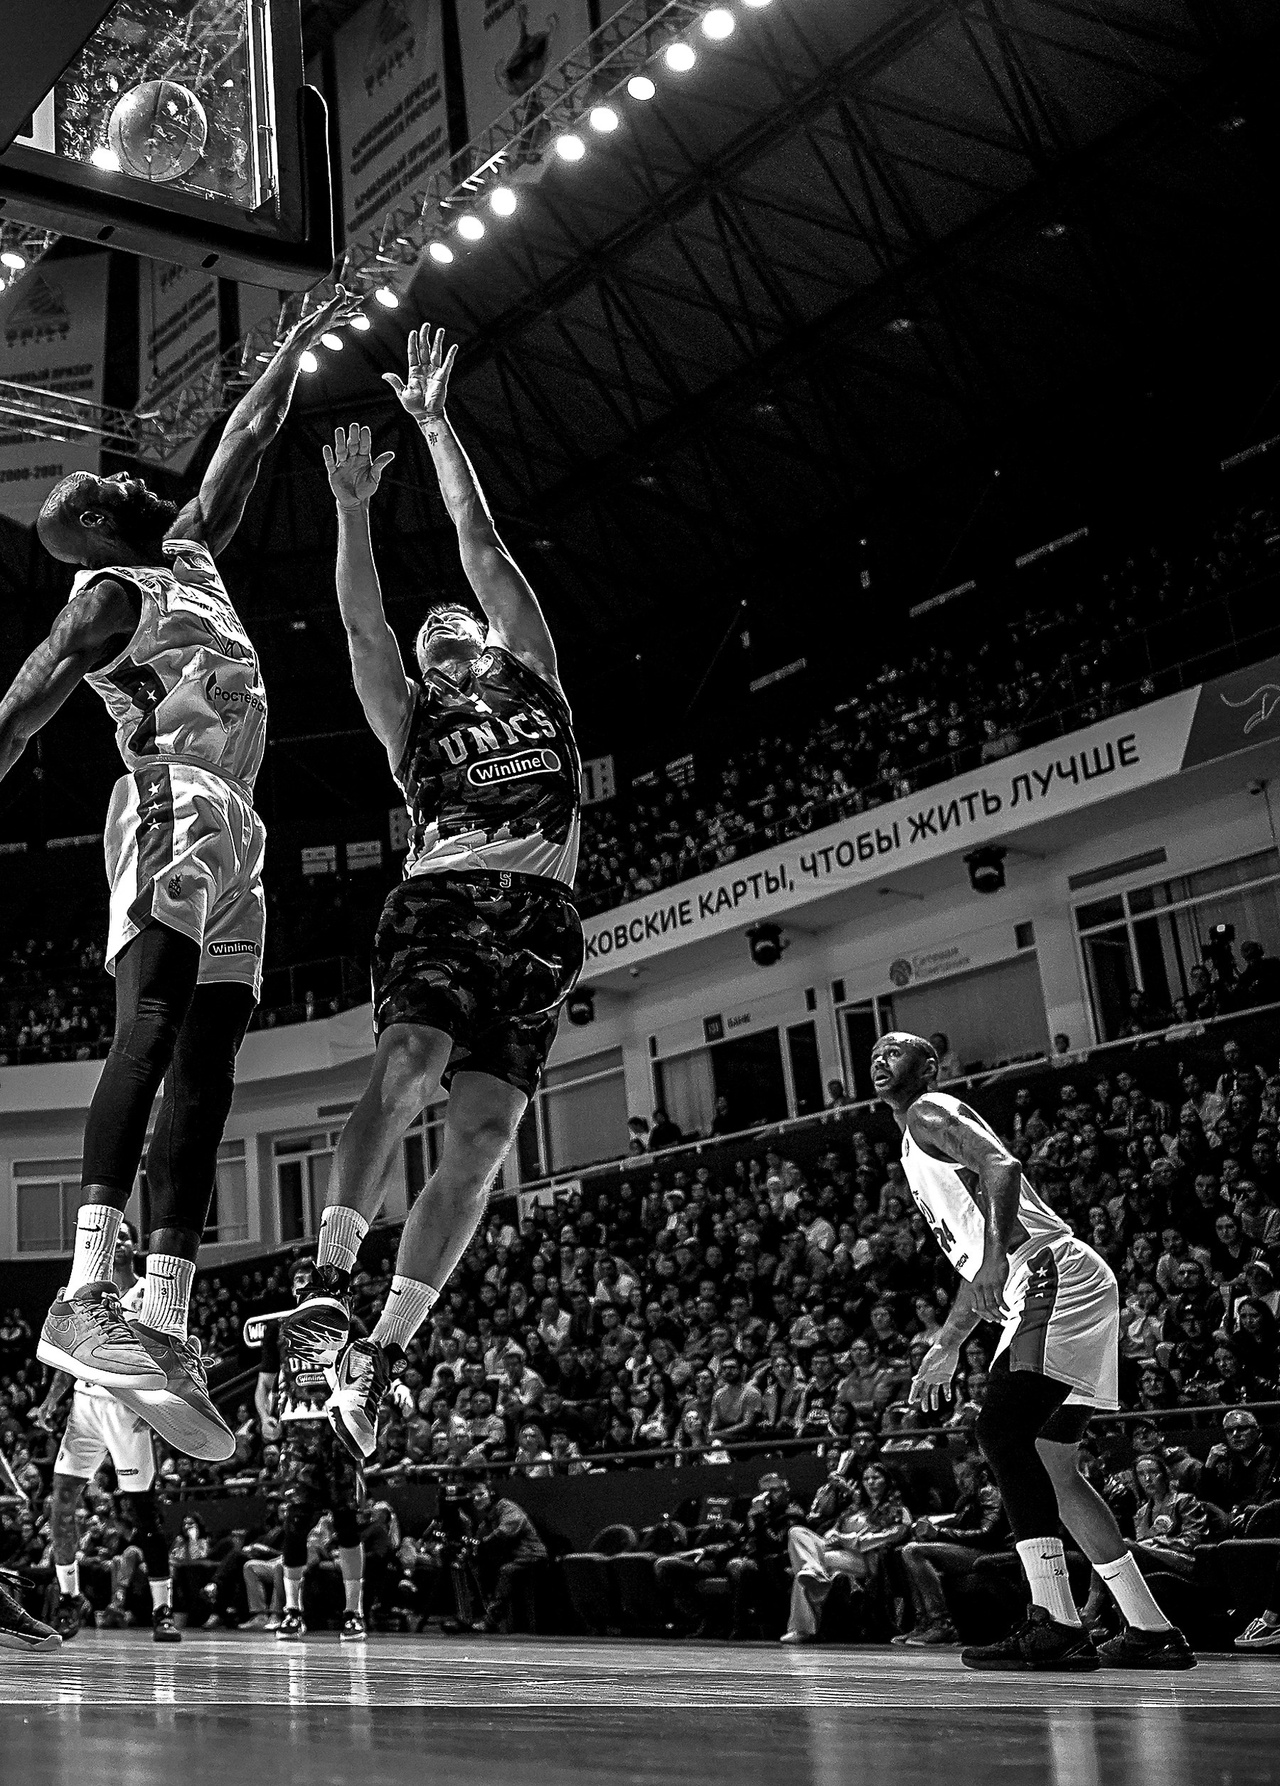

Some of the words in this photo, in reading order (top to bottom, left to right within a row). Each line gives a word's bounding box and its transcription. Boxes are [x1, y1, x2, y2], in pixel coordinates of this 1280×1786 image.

[438, 708, 557, 765] UNICS
[475, 755, 542, 781] Winline
[584, 902, 693, 959] КОВСКИЕ
[698, 862, 795, 919] КАРТЫ,
[799, 820, 902, 879] ЧТОБЫ
[908, 786, 1003, 845] ЖИТЬ
[1008, 733, 1141, 808] ЛУЧШЕ
[212, 942, 254, 954] Winline
[84, 1241, 91, 1249] 3
[161, 1287, 167, 1295] 3
